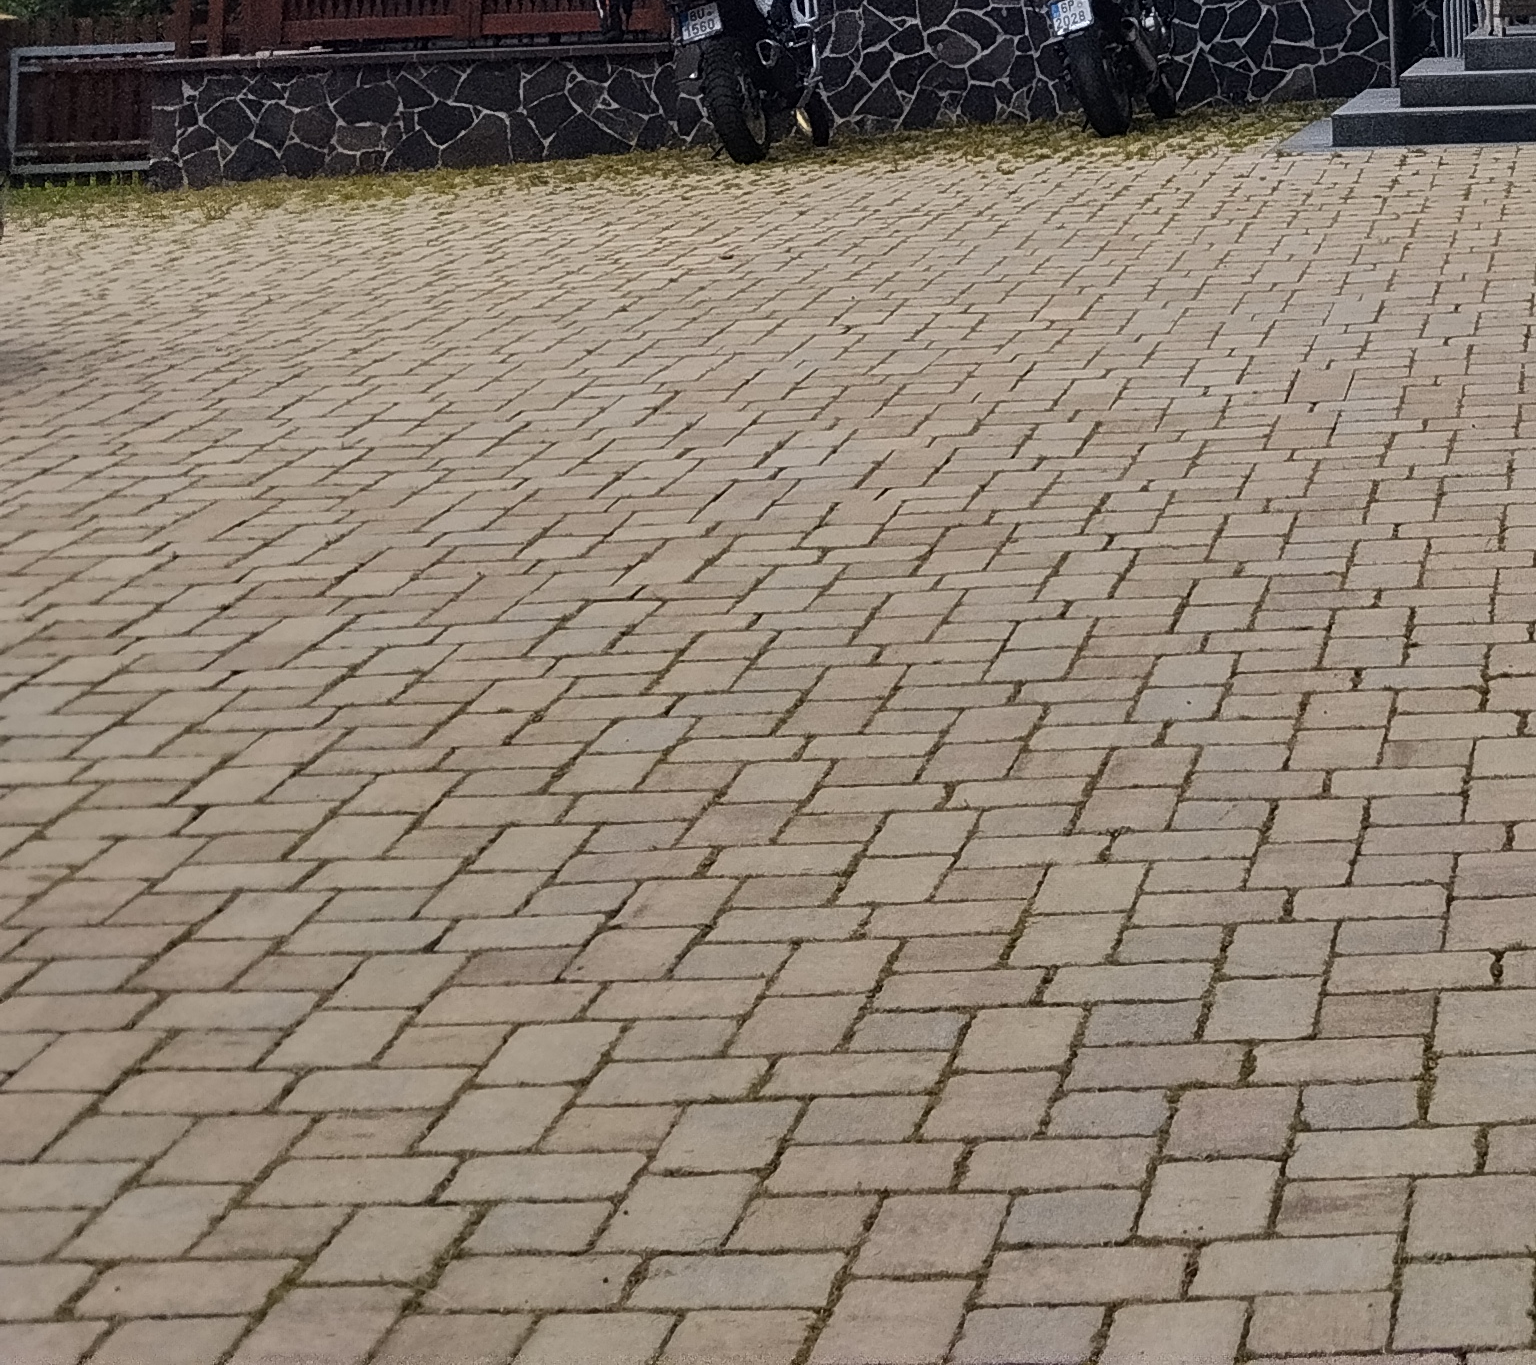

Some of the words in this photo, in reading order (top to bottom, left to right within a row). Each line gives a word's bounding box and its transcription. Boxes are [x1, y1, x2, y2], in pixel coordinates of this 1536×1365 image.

[1061, 0, 1075, 14] 6P
[684, 18, 716, 38] 1560
[1055, 10, 1086, 30] 2028
